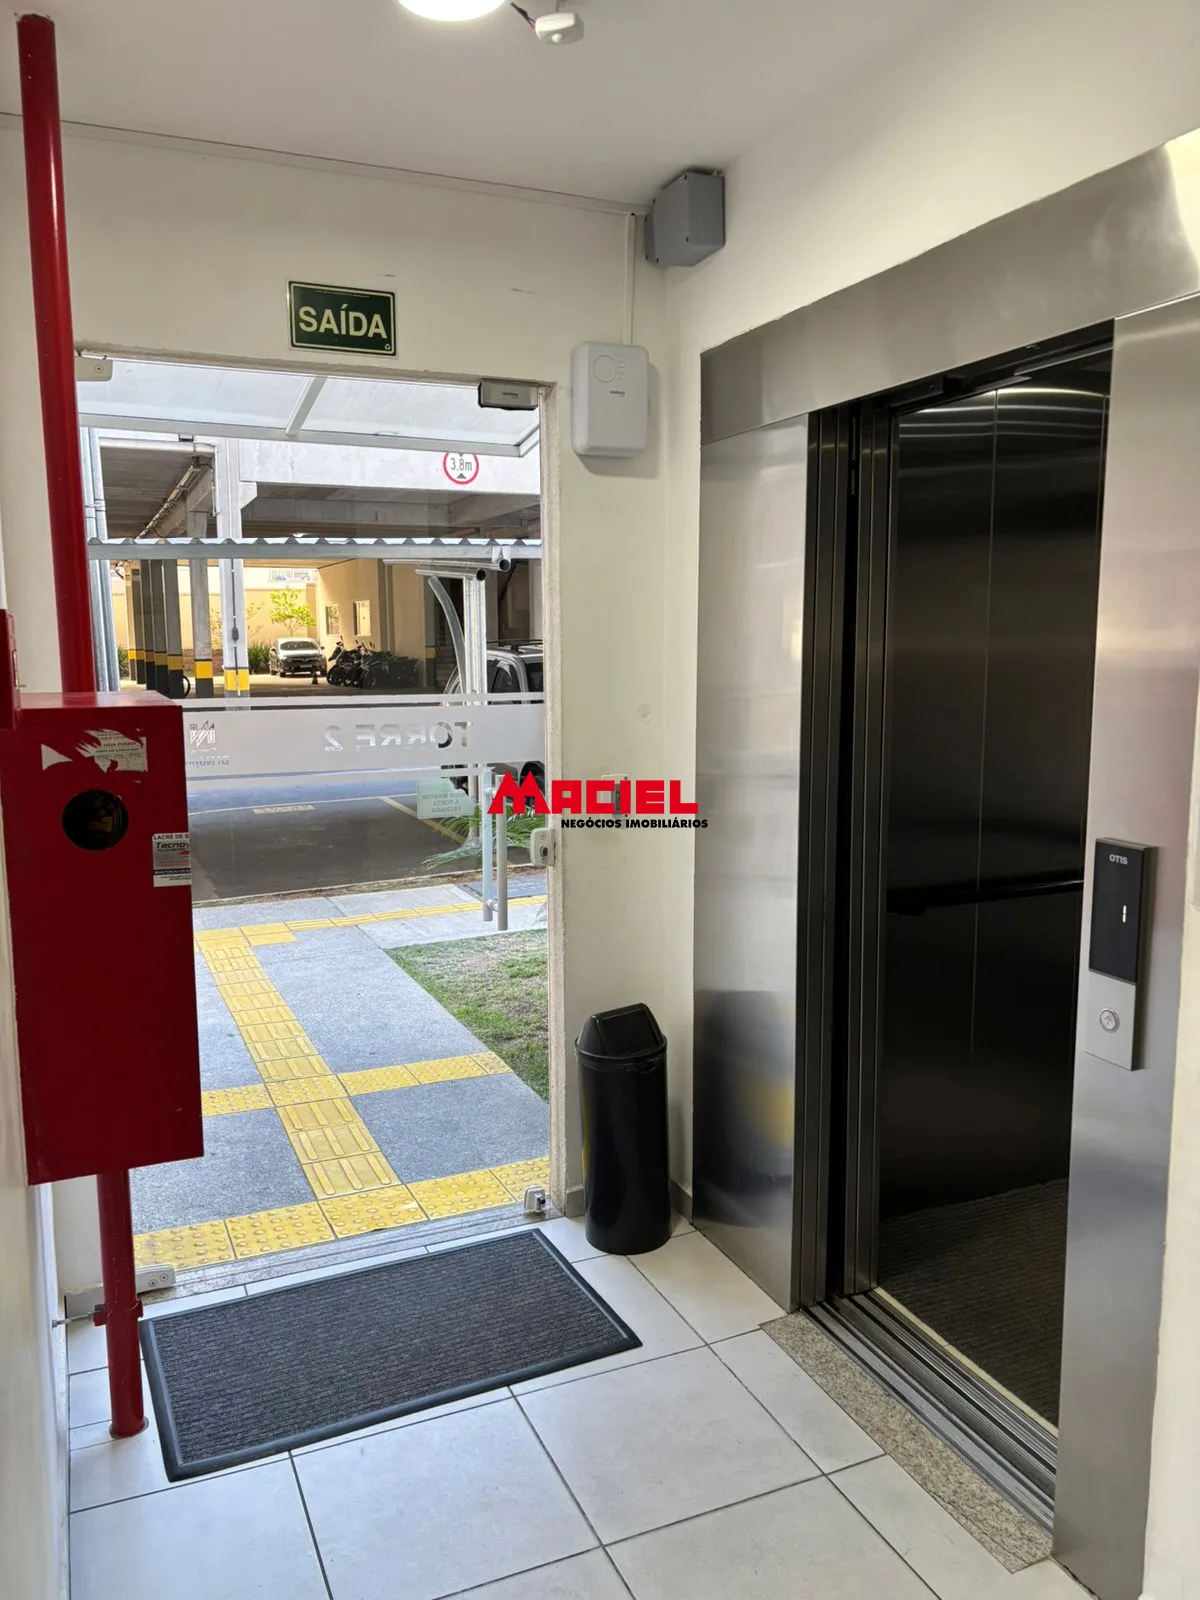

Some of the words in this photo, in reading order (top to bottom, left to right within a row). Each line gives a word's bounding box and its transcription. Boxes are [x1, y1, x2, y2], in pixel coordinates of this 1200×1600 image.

[299, 303, 388, 339] SAÍDA
[450, 457, 473, 471] 3.8m
[1109, 854, 1128, 865] OTIS
